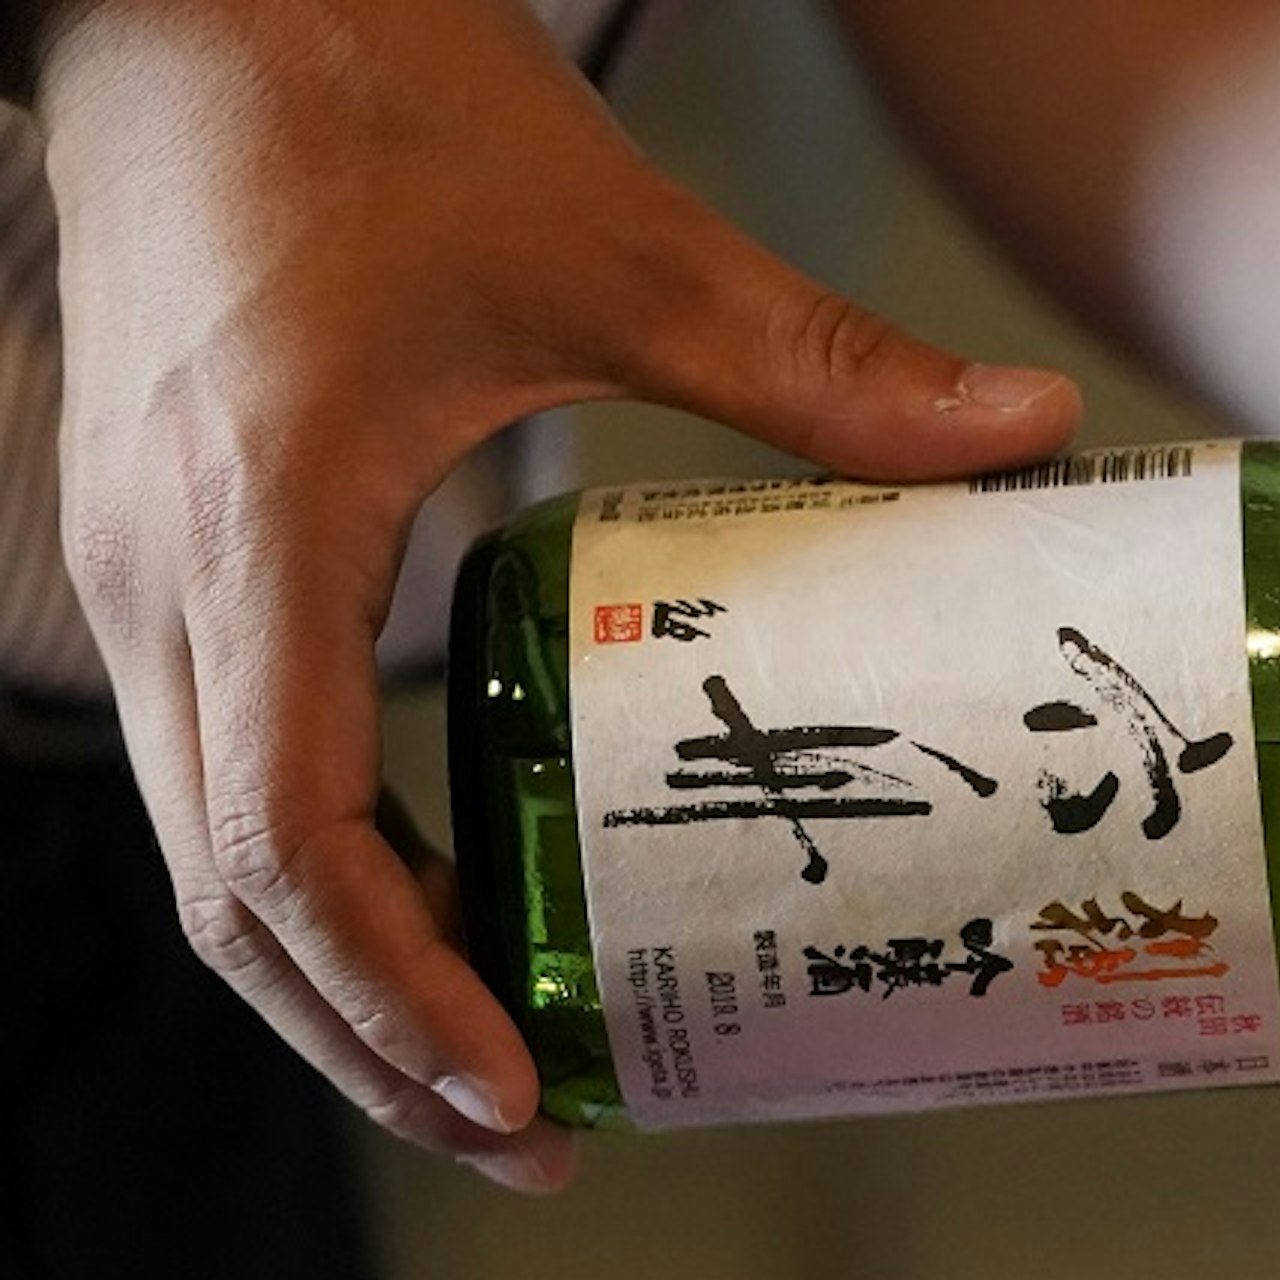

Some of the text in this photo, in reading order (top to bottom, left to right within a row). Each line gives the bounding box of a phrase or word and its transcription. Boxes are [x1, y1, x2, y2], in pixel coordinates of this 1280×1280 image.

[753, 929, 787, 1008] 製造年月
[802, 918, 1014, 999] 吟醸酒
[1061, 994, 1226, 1026] 伝統の銘酒
[667, 1028, 700, 1098] ROKUSHU
